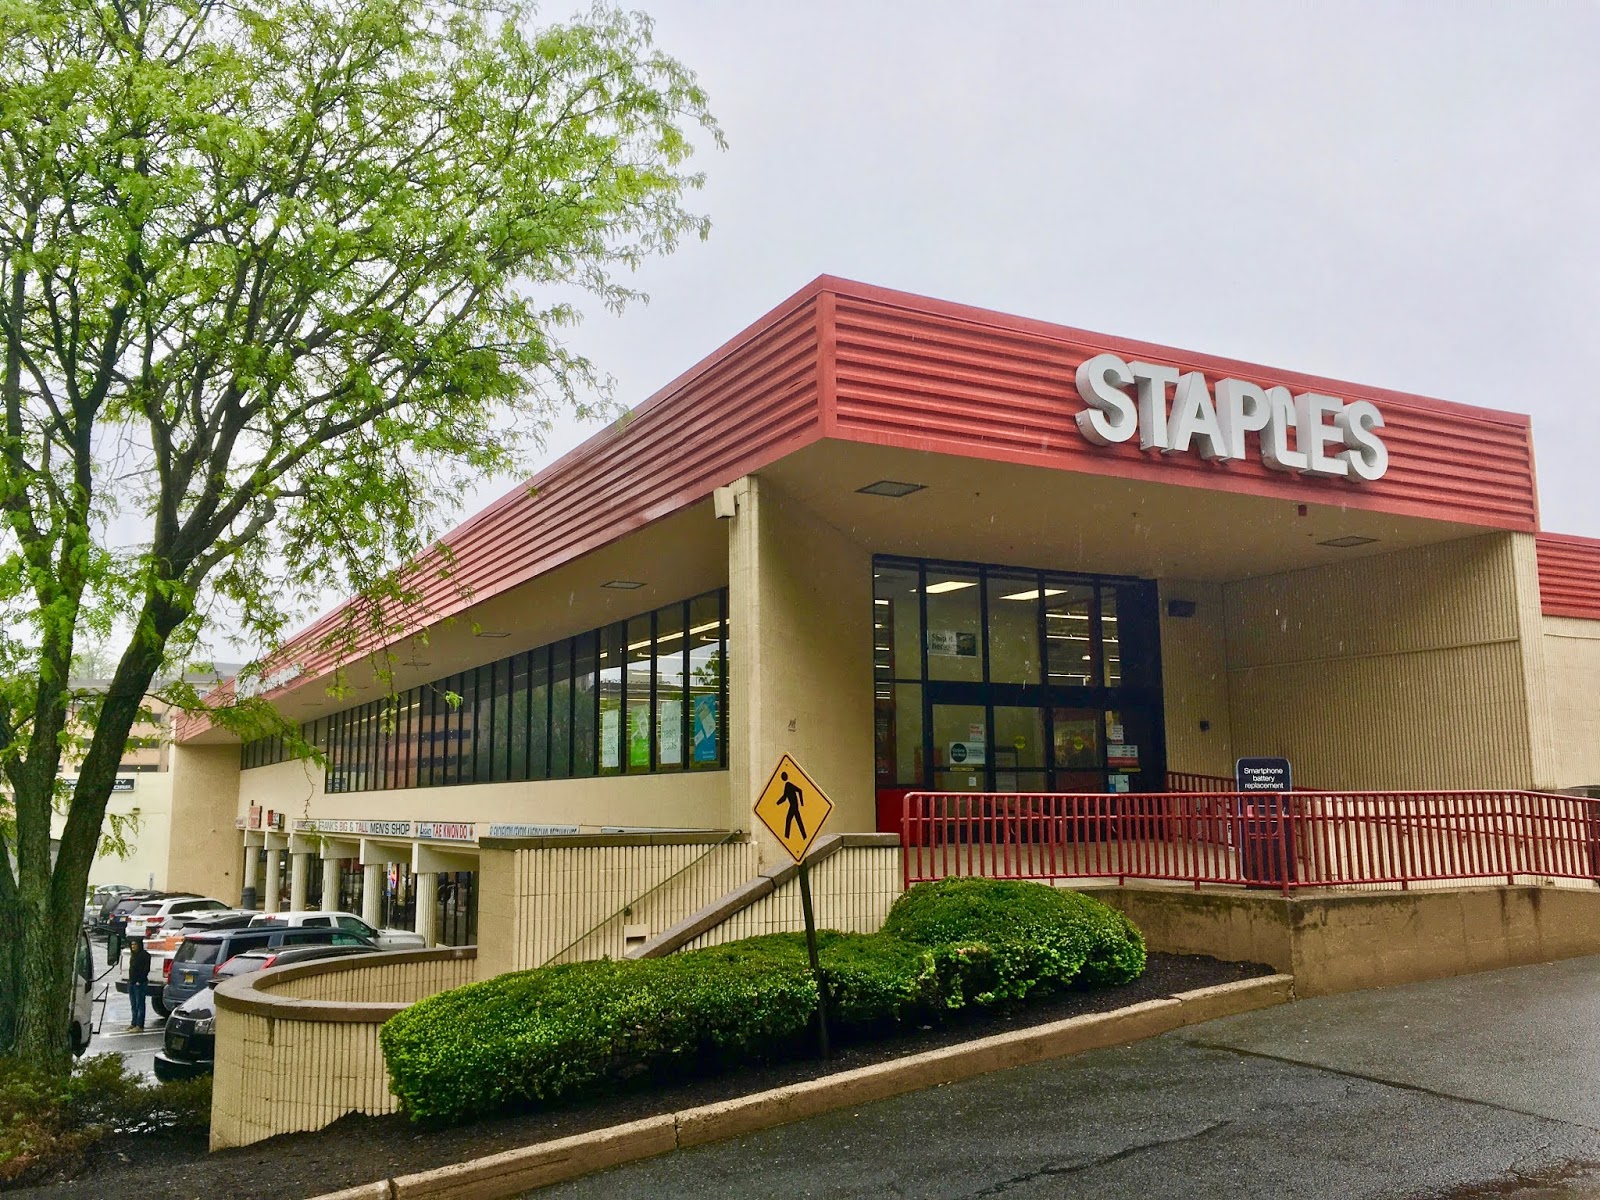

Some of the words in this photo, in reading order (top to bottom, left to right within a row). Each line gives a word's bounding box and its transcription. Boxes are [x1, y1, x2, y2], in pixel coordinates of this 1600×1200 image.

[1075, 353, 1389, 482] STAPLES
[1243, 767, 1283, 775] Smartphone
[339, 822, 348, 831] BIG
[356, 822, 368, 833] TALL
[369, 823, 389, 834] MEN'S
[391, 823, 411, 835] SHOP
[433, 824, 442, 837] TAE
[444, 824, 458, 838] KWON
[460, 825, 468, 839] DO
